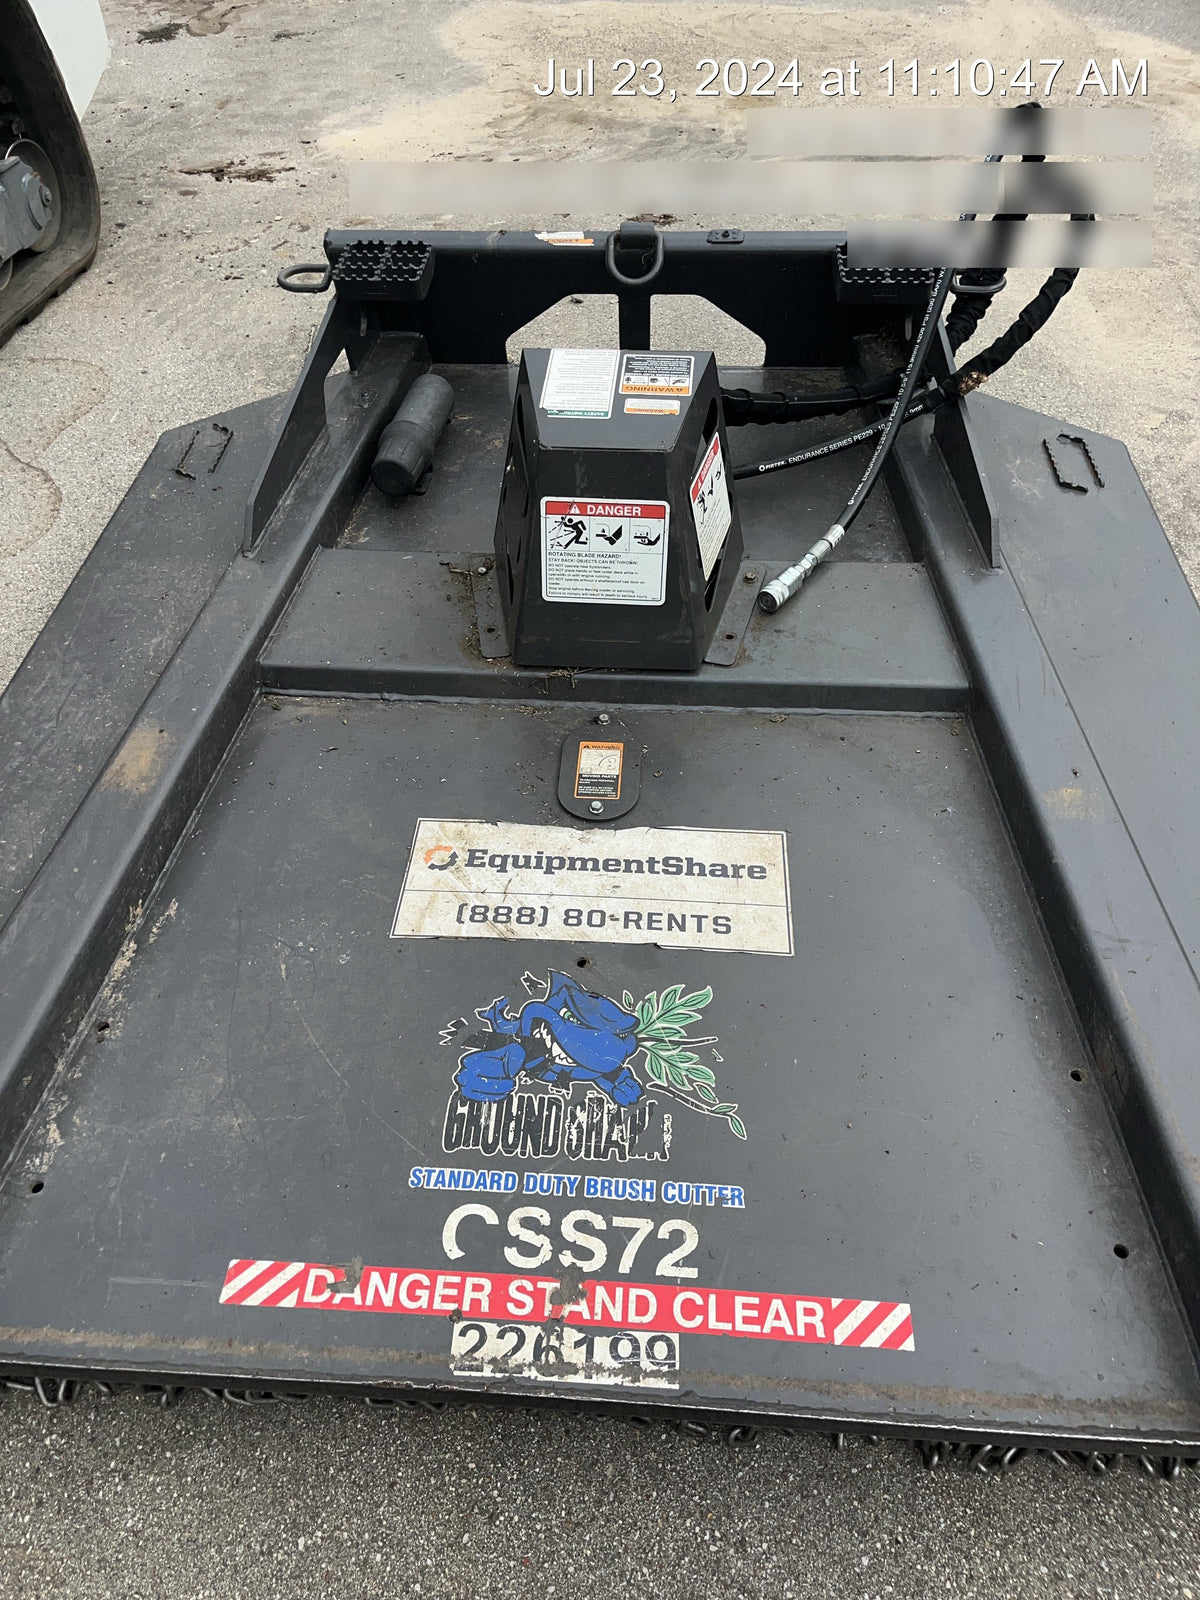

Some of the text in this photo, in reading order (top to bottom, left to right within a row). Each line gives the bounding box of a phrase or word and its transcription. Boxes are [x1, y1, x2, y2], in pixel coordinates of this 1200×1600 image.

[788, 446, 829, 464] ENDURANCE
[828, 437, 853, 451] SERIES
[853, 429, 874, 443] PE229
[587, 504, 642, 517] DANGER
[465, 848, 768, 880] EquipmentShare
[456, 902, 732, 935] (888) 80-RENTS
[564, 1091, 671, 1162] SHAR
[409, 1167, 745, 1208] STANDARD DUTY BRUSH CUTTER
[442, 1203, 699, 1279] CSS72
[506, 1279, 657, 1324] STAND
[672, 1291, 826, 1338] CLEAR
[453, 1323, 677, 1384] 226199
